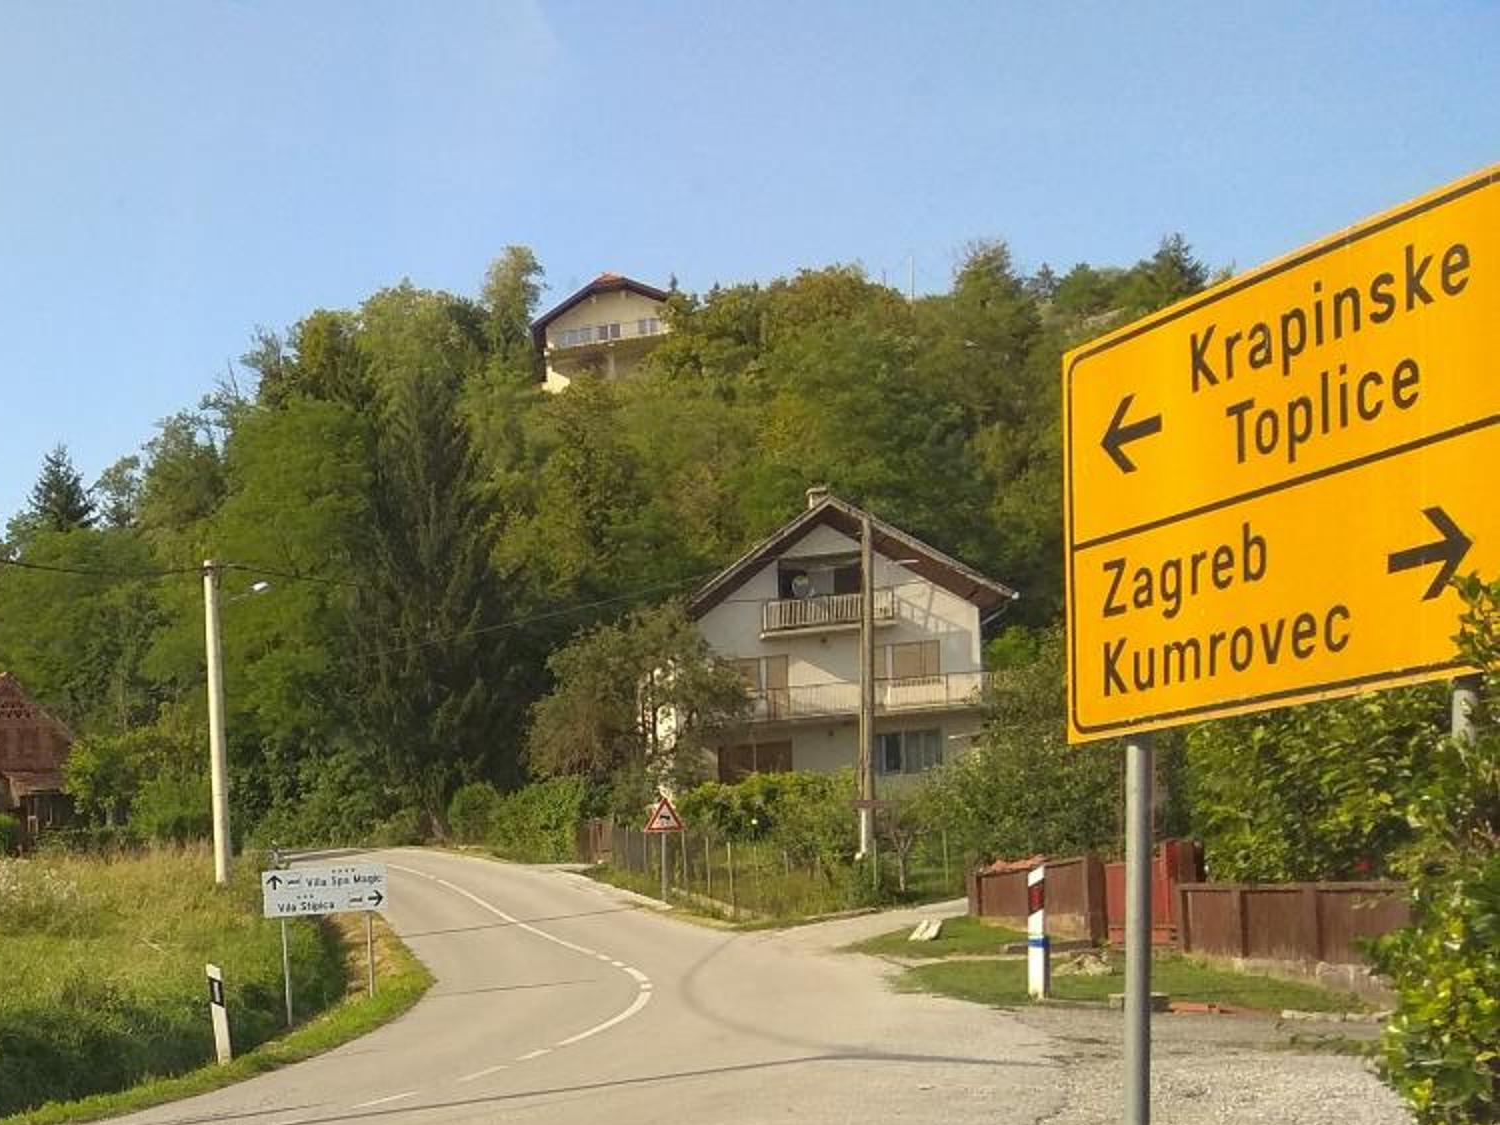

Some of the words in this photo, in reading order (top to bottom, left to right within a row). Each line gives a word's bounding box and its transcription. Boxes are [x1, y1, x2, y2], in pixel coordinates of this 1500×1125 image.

[1189, 241, 1471, 393] Krapinske
[1226, 357, 1421, 465] Toplice
[1103, 522, 1267, 619] Zagreb
[1103, 602, 1351, 697] Kumrovec
